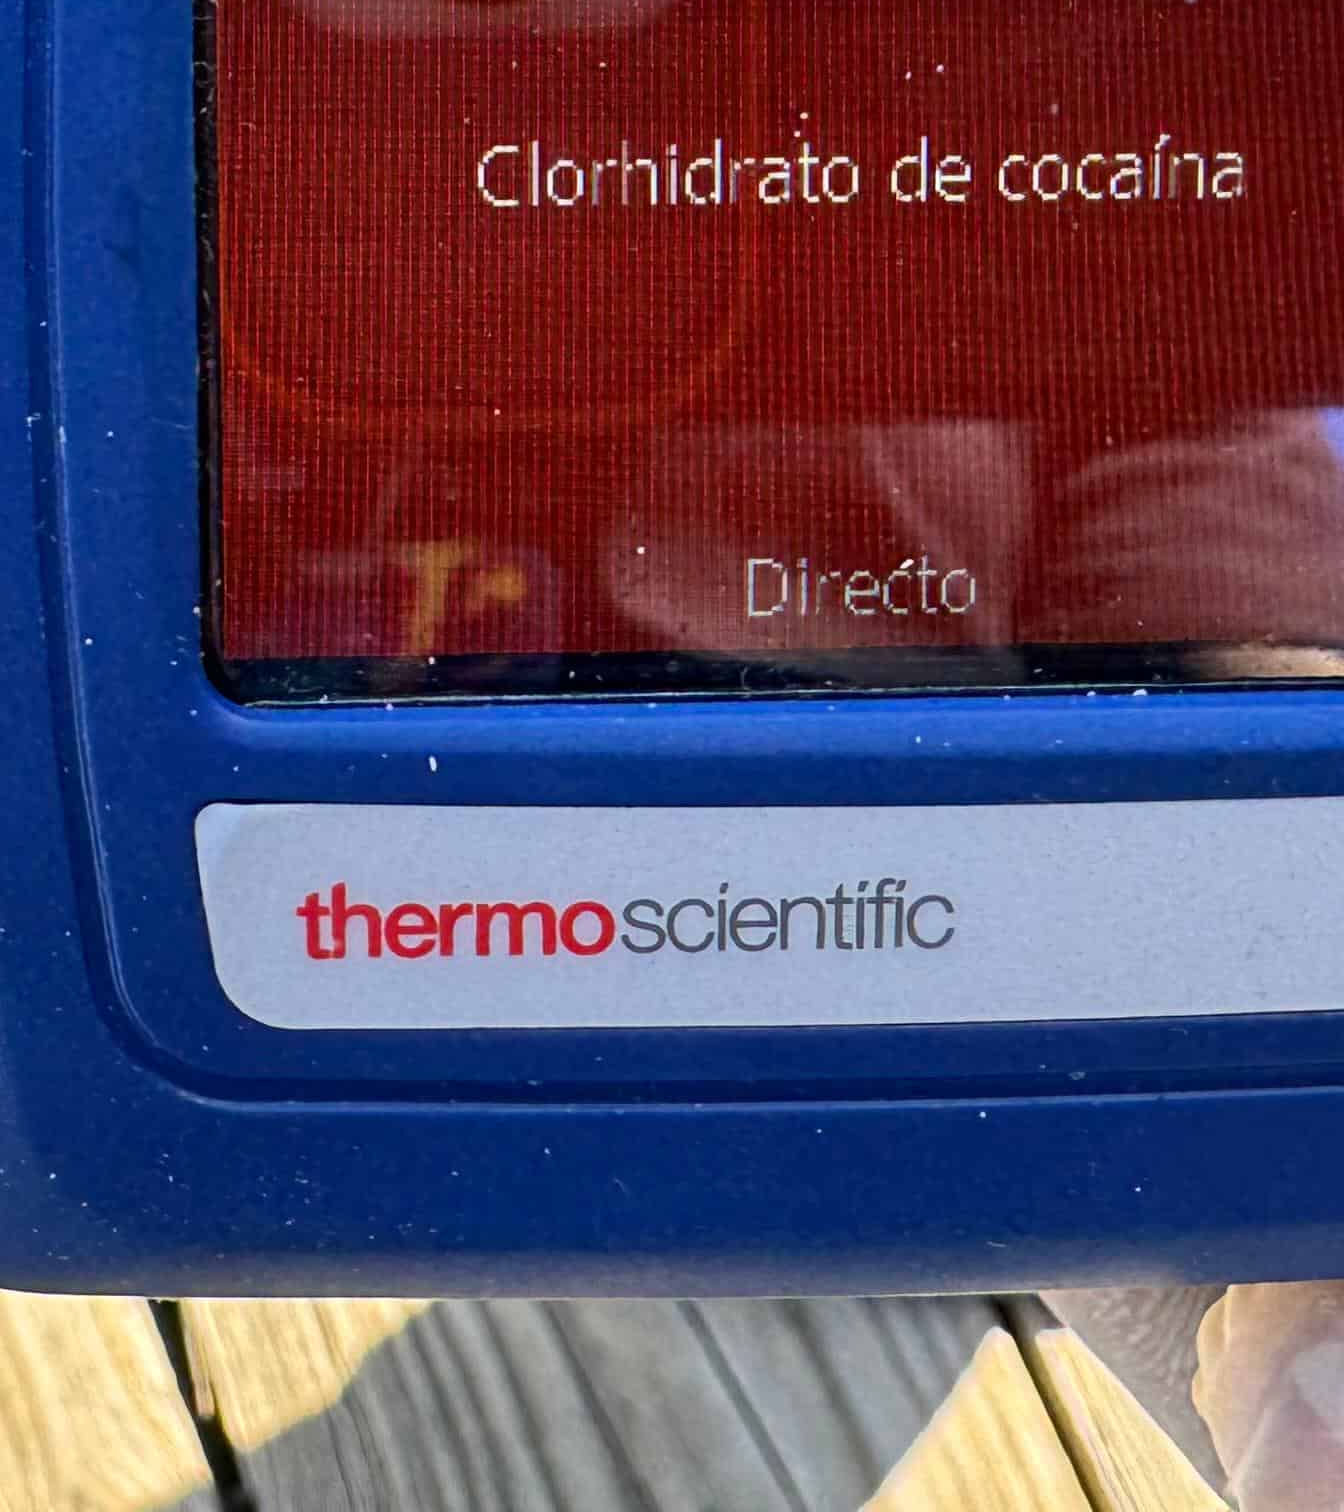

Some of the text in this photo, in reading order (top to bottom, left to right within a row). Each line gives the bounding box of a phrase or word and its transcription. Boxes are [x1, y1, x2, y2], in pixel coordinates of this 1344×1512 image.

[476, 133, 1247, 207] Clorhidrato de cocaína
